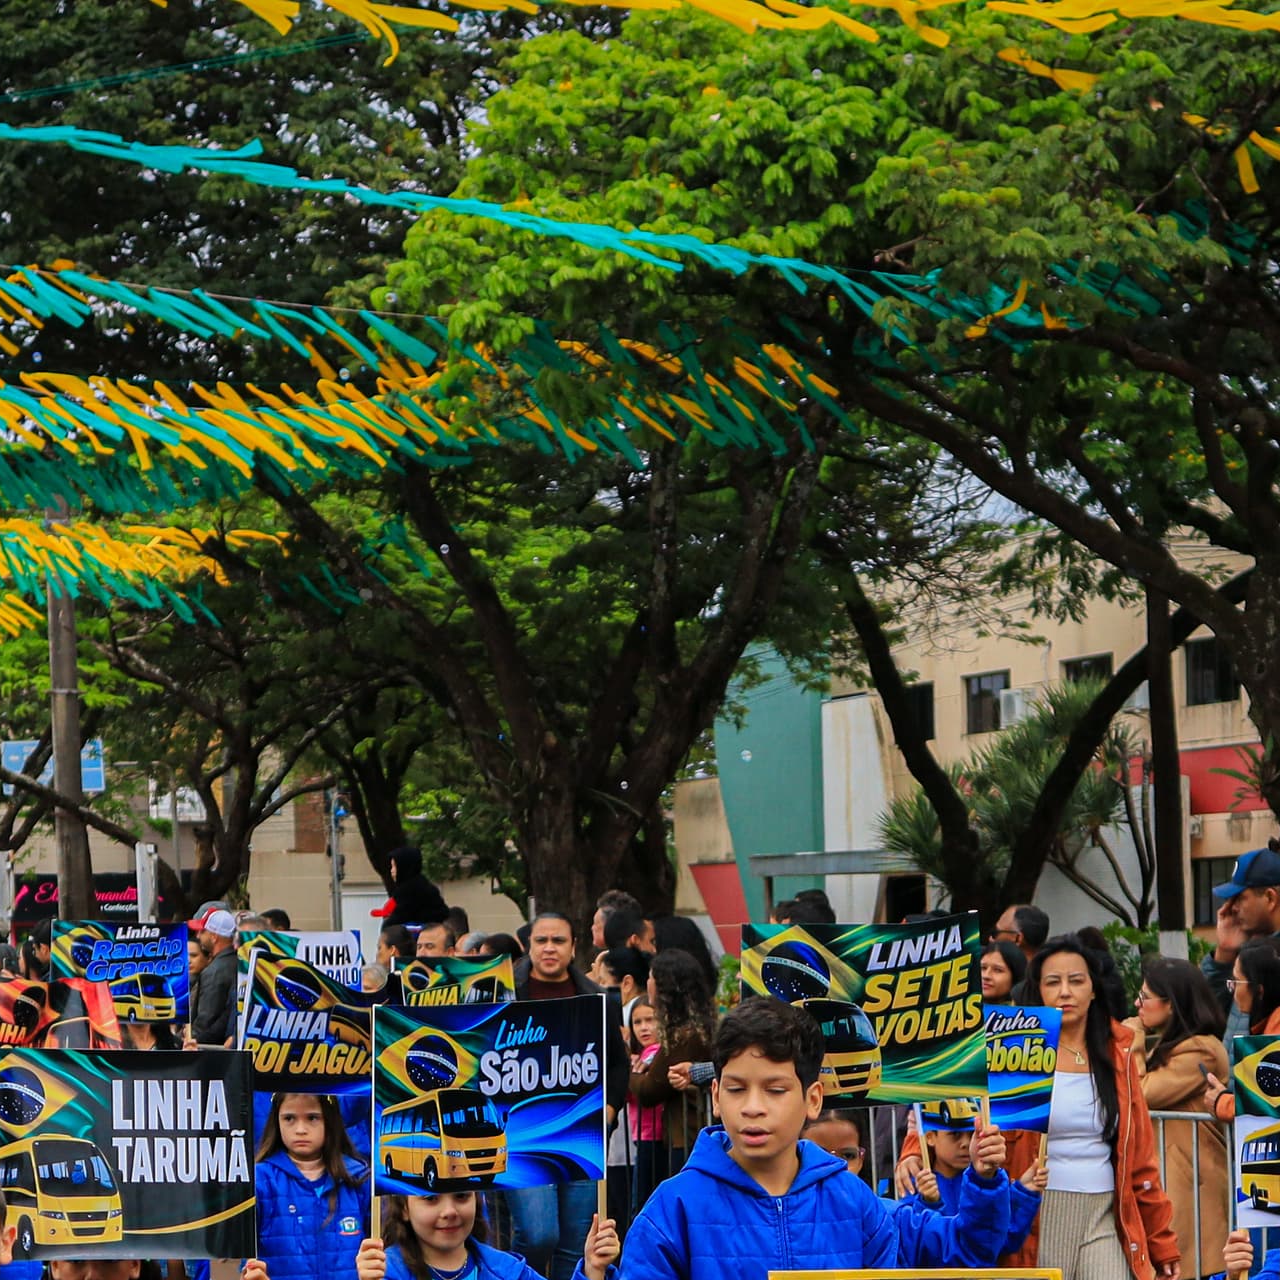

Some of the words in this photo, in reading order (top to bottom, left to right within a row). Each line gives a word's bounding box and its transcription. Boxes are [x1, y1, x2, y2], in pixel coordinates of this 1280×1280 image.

[91, 937, 182, 961] Rancho
[116, 925, 160, 940] Linha
[867, 924, 962, 972] LINHA
[86, 956, 184, 981] Grande
[863, 953, 972, 1014] SETE
[247, 1004, 329, 1040] LINHA
[495, 1016, 548, 1050] Linha
[876, 994, 983, 1048] VOLTAS
[985, 1009, 1040, 1037] Linha
[479, 1049, 540, 1096] São
[541, 1042, 599, 1089] José
[112, 1079, 231, 1130] LINHA
[112, 1129, 250, 1183] TARUMÃ
